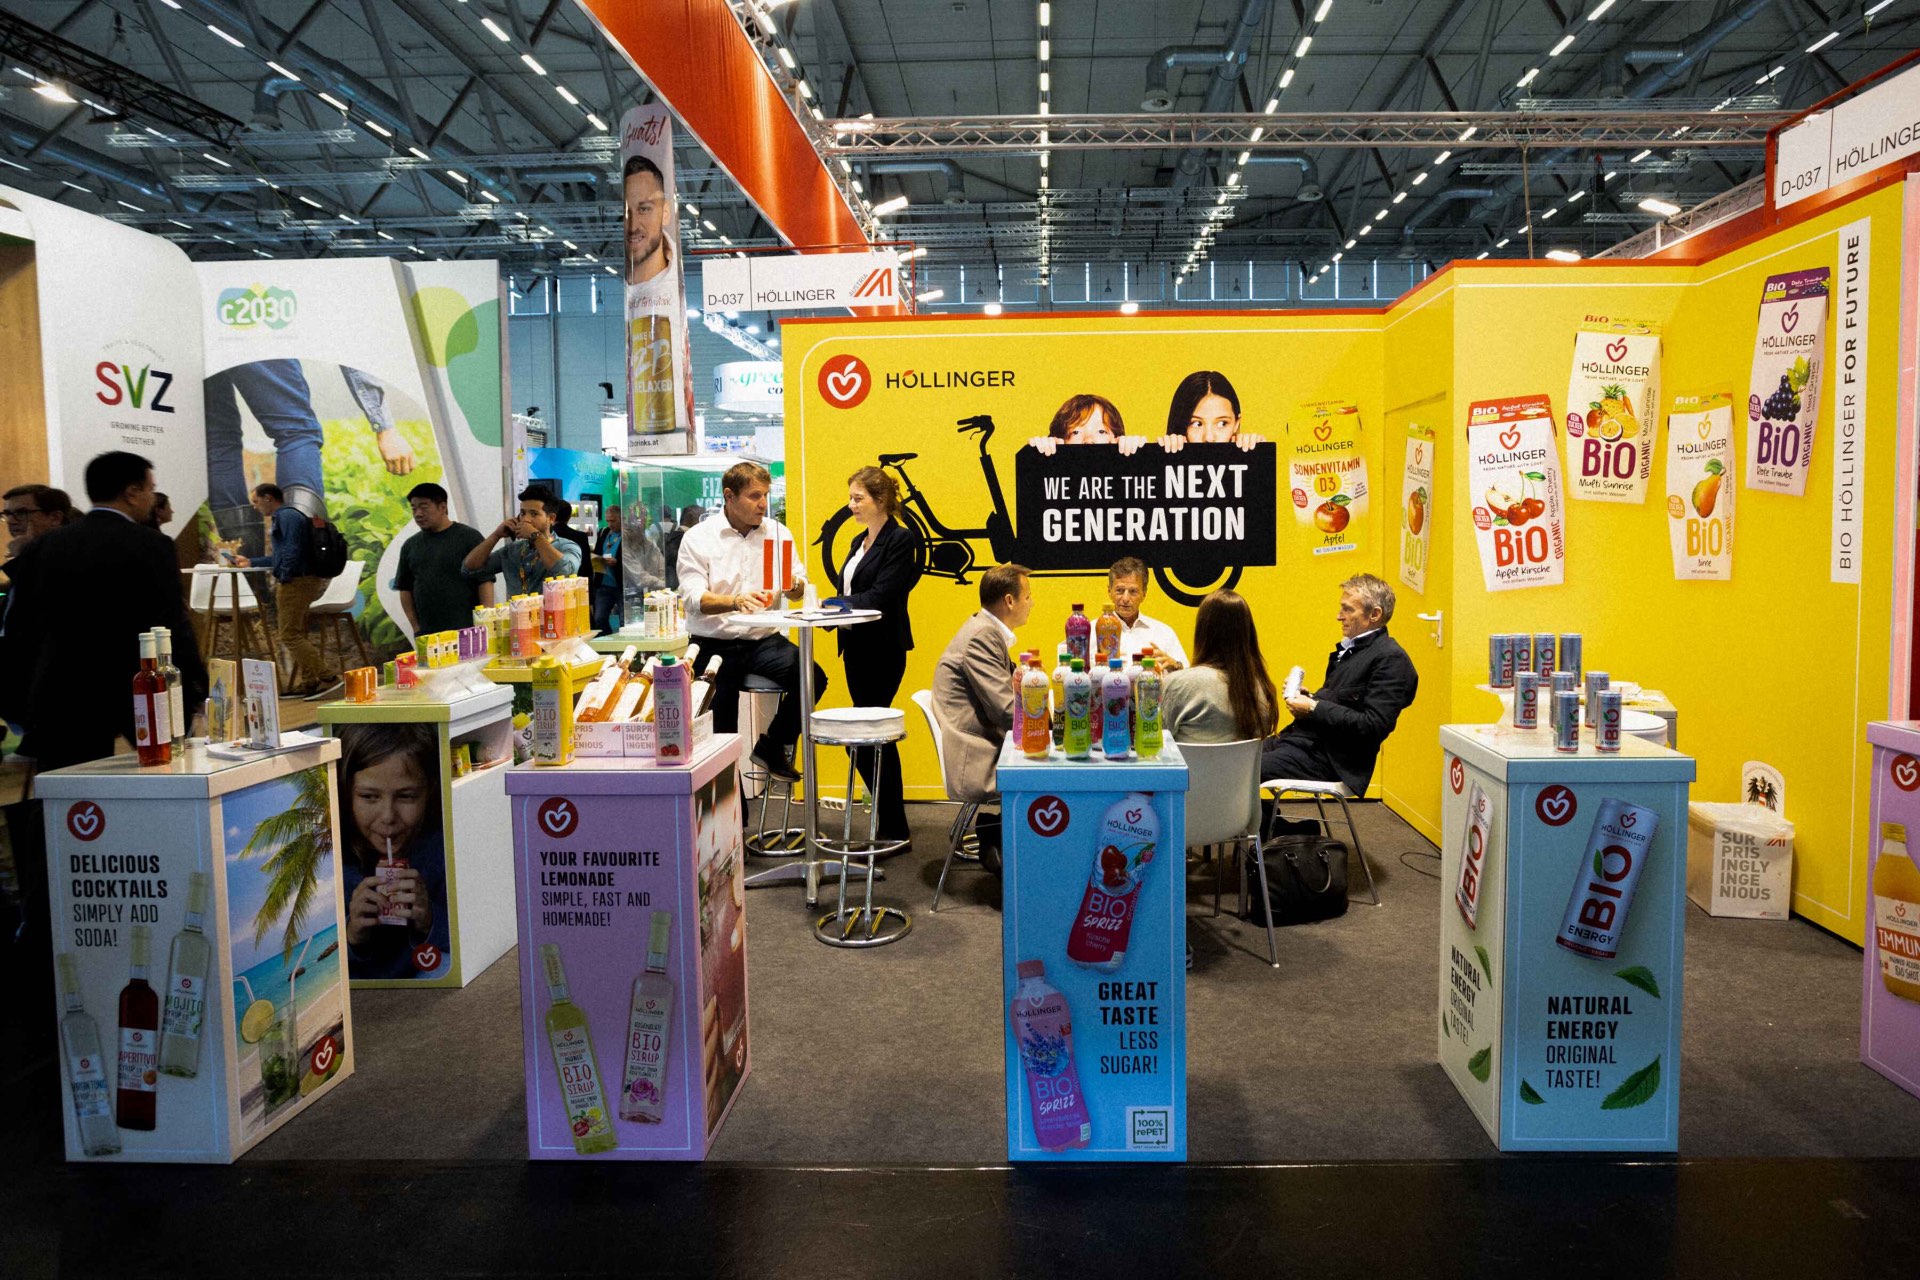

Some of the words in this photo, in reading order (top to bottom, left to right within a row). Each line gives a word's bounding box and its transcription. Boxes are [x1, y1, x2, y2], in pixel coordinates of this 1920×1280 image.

[1781, 166, 1821, 197] D-037
[850, 273, 869, 297] AUSTRIA
[1766, 281, 1786, 292] BiO
[1845, 235, 1860, 330] FUTURE
[708, 293, 744, 306] D-037
[757, 288, 836, 303] HÖLLINGER
[221, 296, 296, 324] c2030
[1844, 338, 1857, 385] FOR
[96, 361, 175, 414] SVZ
[633, 379, 673, 393] RELAXED
[111, 421, 140, 432] GROWING
[141, 424, 165, 434] BETTER
[121, 435, 155, 446] TOGETHER
[1757, 421, 1800, 467] BiO
[1802, 420, 1813, 467] ORGANIC
[1293, 456, 1360, 476] SONNENVITAMIN
[1582, 438, 1637, 479] BiO
[1640, 439, 1651, 479] ORGANIC
[1838, 393, 1856, 522] HÖLLINGER
[1044, 476, 1071, 500] WE
[1078, 476, 1114, 500] ARE
[1121, 475, 1157, 499] THE
[1165, 464, 1249, 499] NEXT
[1547, 467, 1555, 494] Cherry
[1756, 465, 1770, 477] Rote
[1771, 467, 1794, 480] Traube
[1319, 476, 1337, 493] D3
[1579, 478, 1601, 489] Multi
[1603, 480, 1634, 491] Sunrise
[1042, 506, 1245, 543] GENERATION
[1323, 533, 1345, 546] Apfel
[1494, 525, 1549, 567] BiO
[1552, 519, 1564, 560] ORGANIC
[1686, 517, 1723, 557] BiO
[1404, 530, 1423, 571] BiO
[1839, 531, 1852, 569] BIO
[1495, 566, 1519, 580] Apfel
[1521, 565, 1551, 576] Kirsche
[658, 707, 680, 720] BIO
[1522, 688, 1537, 720] BIO
[535, 708, 556, 721] BIO
[535, 721, 556, 730] SIRUP
[658, 720, 680, 729] SIRUP
[1027, 720, 1045, 729] BIO
[1071, 720, 1088, 730] BIO
[1108, 720, 1125, 731] BIO
[1142, 722, 1159, 732] BIO
[1604, 708, 1620, 741] BIO
[626, 733, 650, 741] INGLY
[1721, 831, 1756, 846] SUR
[540, 851, 578, 867] YOUR
[583, 851, 660, 867] FAVOURITE
[1721, 845, 1760, 859] PRIS
[70, 854, 160, 873] DELICIOUS
[1463, 824, 1483, 903] BIO
[1721, 858, 1770, 873] INGLY
[72, 879, 168, 898] COCKTAILS
[541, 871, 615, 887] LEMONADE
[1578, 844, 1632, 931] BIO
[1720, 872, 1761, 887] INGE
[542, 891, 588, 909] SIMPLE,
[592, 892, 622, 907] FAST
[627, 892, 651, 907] AND
[1719, 885, 1771, 901] NIOUS
[73, 903, 123, 923] SIMPLY
[130, 904, 159, 923] ADD
[1088, 892, 1127, 919] BIO
[542, 911, 611, 927] HOMEMADE!
[1083, 914, 1124, 931] SPRIZZ
[75, 928, 118, 947] SODA!
[1085, 940, 1107, 952] cherry
[1451, 944, 1481, 992] NATURAL
[1098, 981, 1159, 1001] GREAT
[1451, 966, 1476, 1008] ENERGY
[165, 995, 204, 1014] MOJITO
[1450, 987, 1475, 1032] ORIGINAL
[1547, 996, 1633, 1015] NATURAL
[1099, 1006, 1159, 1025] TASTE
[1450, 1008, 1469, 1047] TASTE!
[1547, 1020, 1619, 1040] ENERGY
[632, 1031, 661, 1052] BIO
[1119, 1031, 1159, 1050] LESS
[118, 1051, 156, 1065] APERITIVO
[631, 1051, 660, 1064] SIRUP
[1546, 1045, 1617, 1064] ORIGINAL
[562, 1063, 592, 1084] BIO
[1100, 1055, 1158, 1075] SUGAR!
[566, 1081, 595, 1095] SIRUP
[1035, 1077, 1073, 1099] BIO
[1545, 1069, 1600, 1089] TASTE!
[1039, 1094, 1075, 1115] SPRIZZ
[1136, 1128, 1165, 1136] rePET
[1137, 1119, 1164, 1127] 100%
